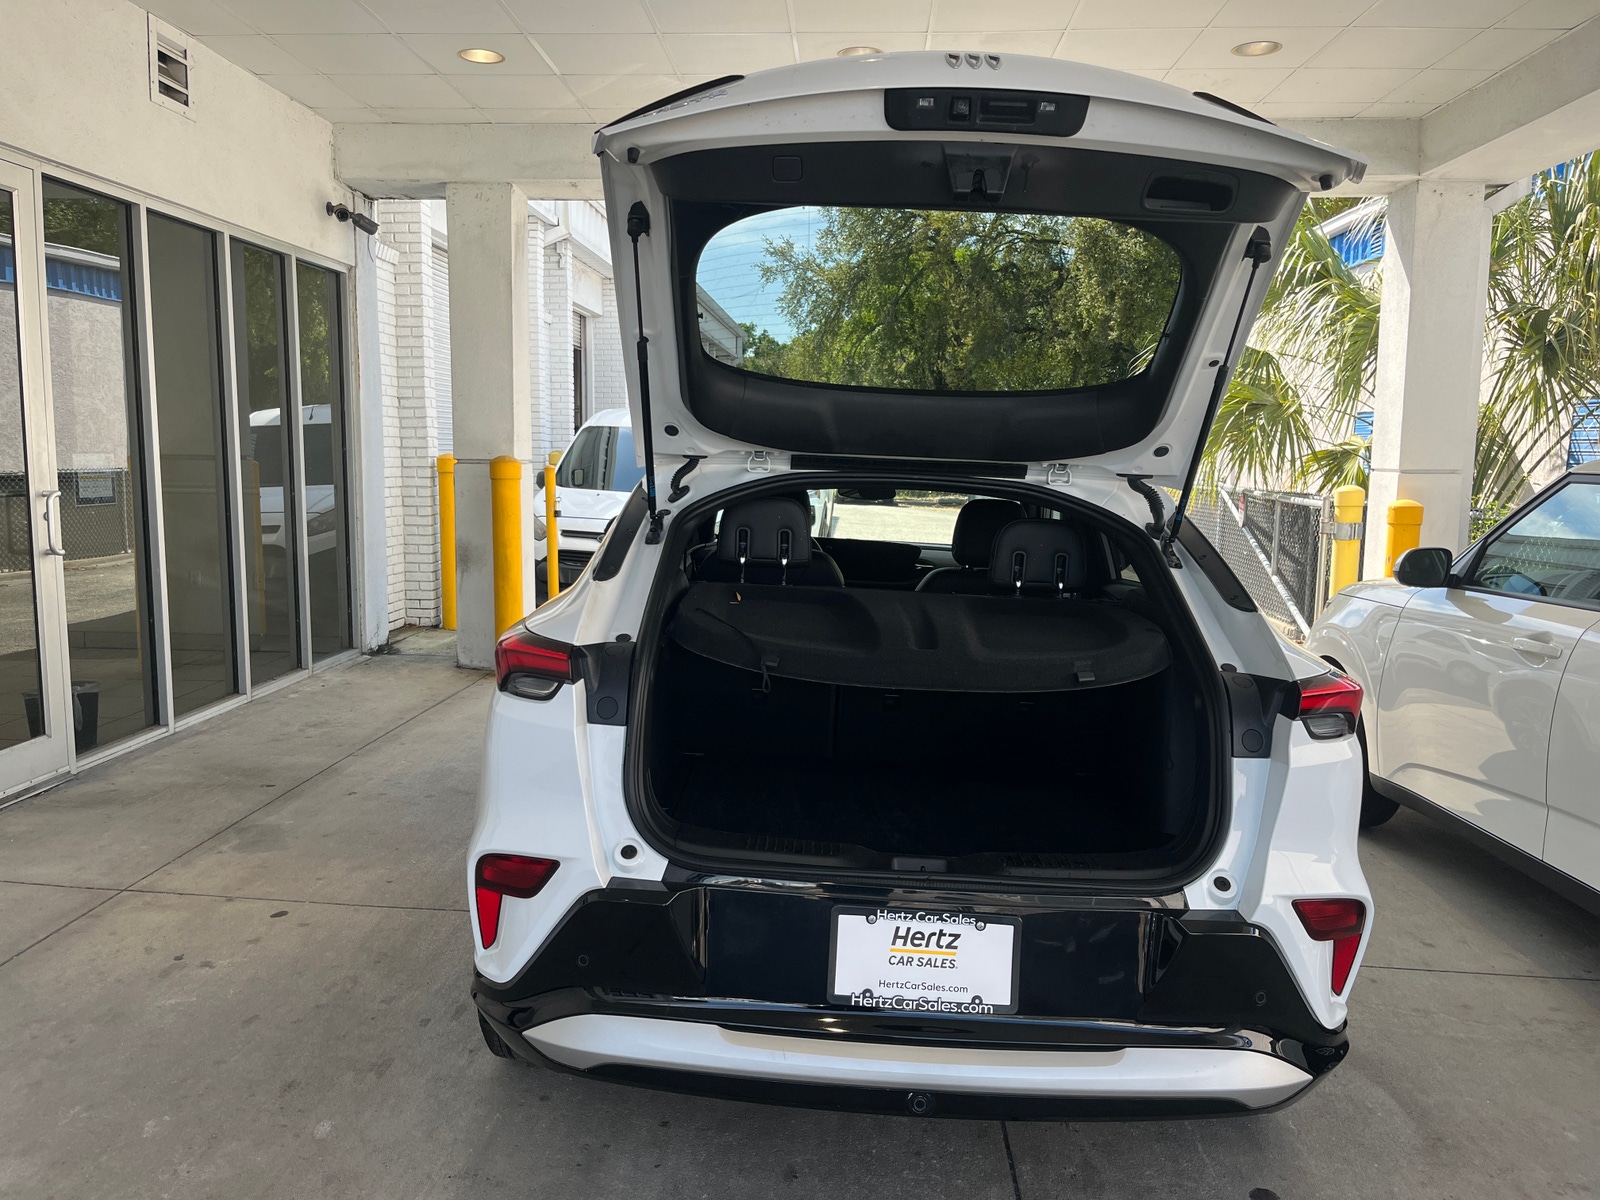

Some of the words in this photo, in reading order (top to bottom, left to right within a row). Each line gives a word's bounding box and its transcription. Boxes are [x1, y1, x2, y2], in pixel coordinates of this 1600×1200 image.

[877, 909, 914, 922] Hertz
[915, 911, 939, 923] Car
[940, 913, 976, 926] Sales
[891, 926, 961, 950] Hertz
[888, 955, 913, 967] CAR
[878, 979, 968, 993] HertzCarSales.com
[851, 993, 993, 1014] HertzCarSales.com
